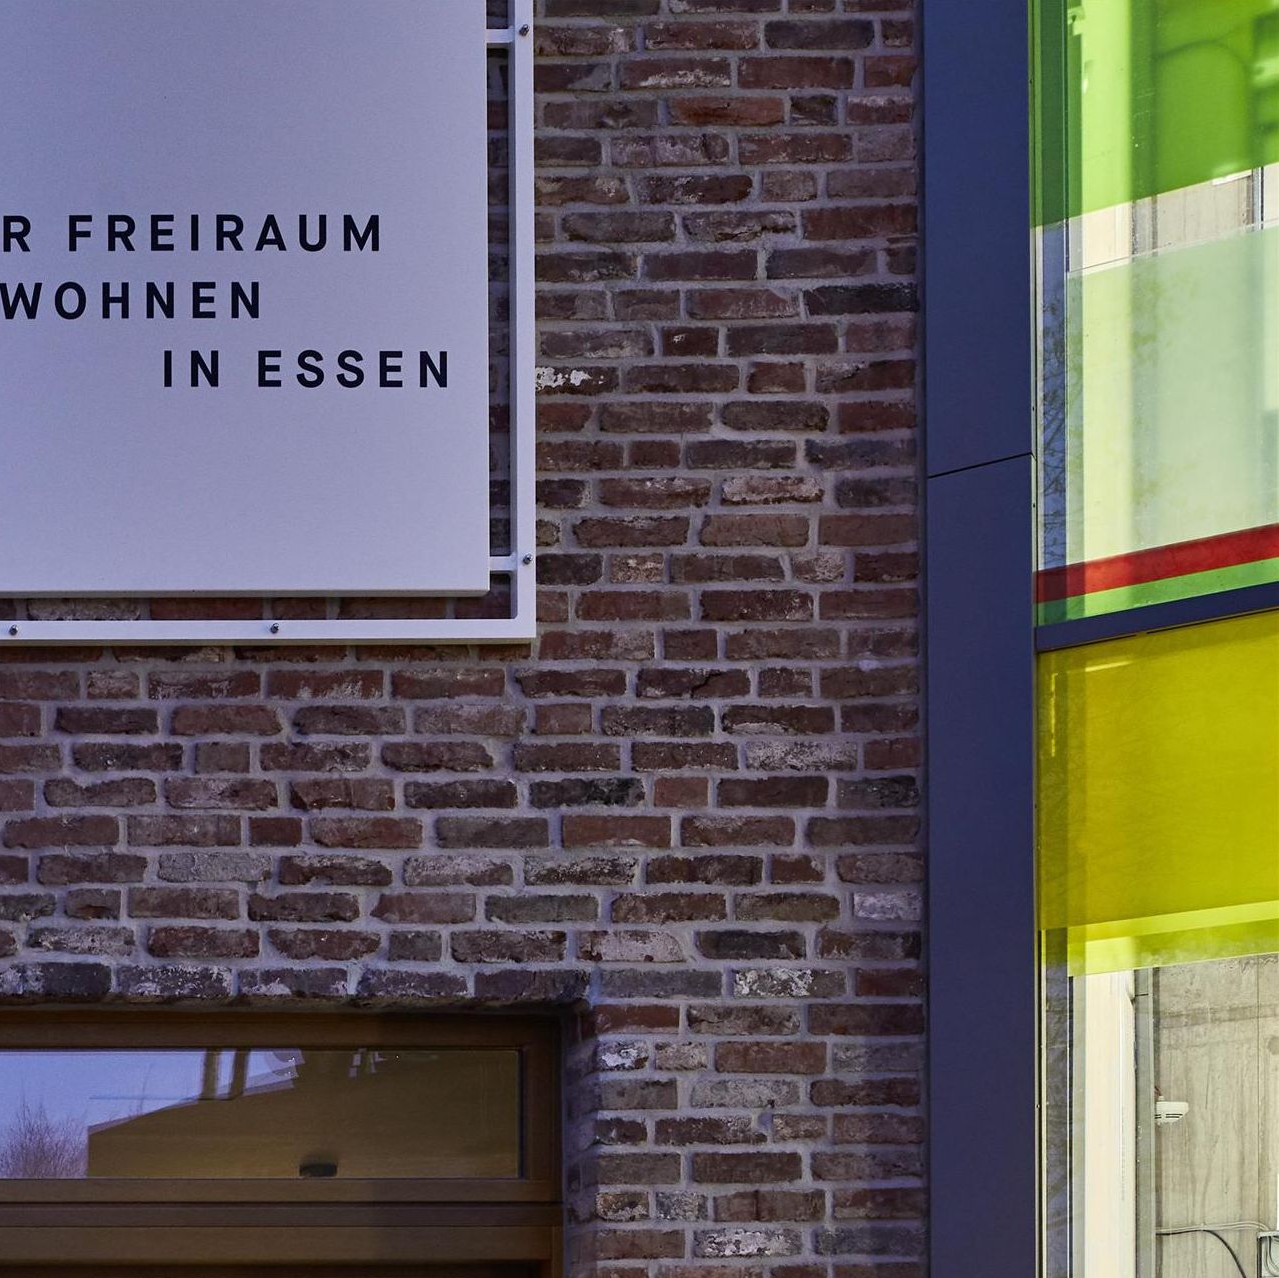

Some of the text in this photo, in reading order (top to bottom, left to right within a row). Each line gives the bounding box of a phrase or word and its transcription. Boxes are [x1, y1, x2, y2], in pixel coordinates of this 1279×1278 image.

[68, 214, 381, 252] FREIRAUM
[163, 349, 448, 389] IN ESSEN
